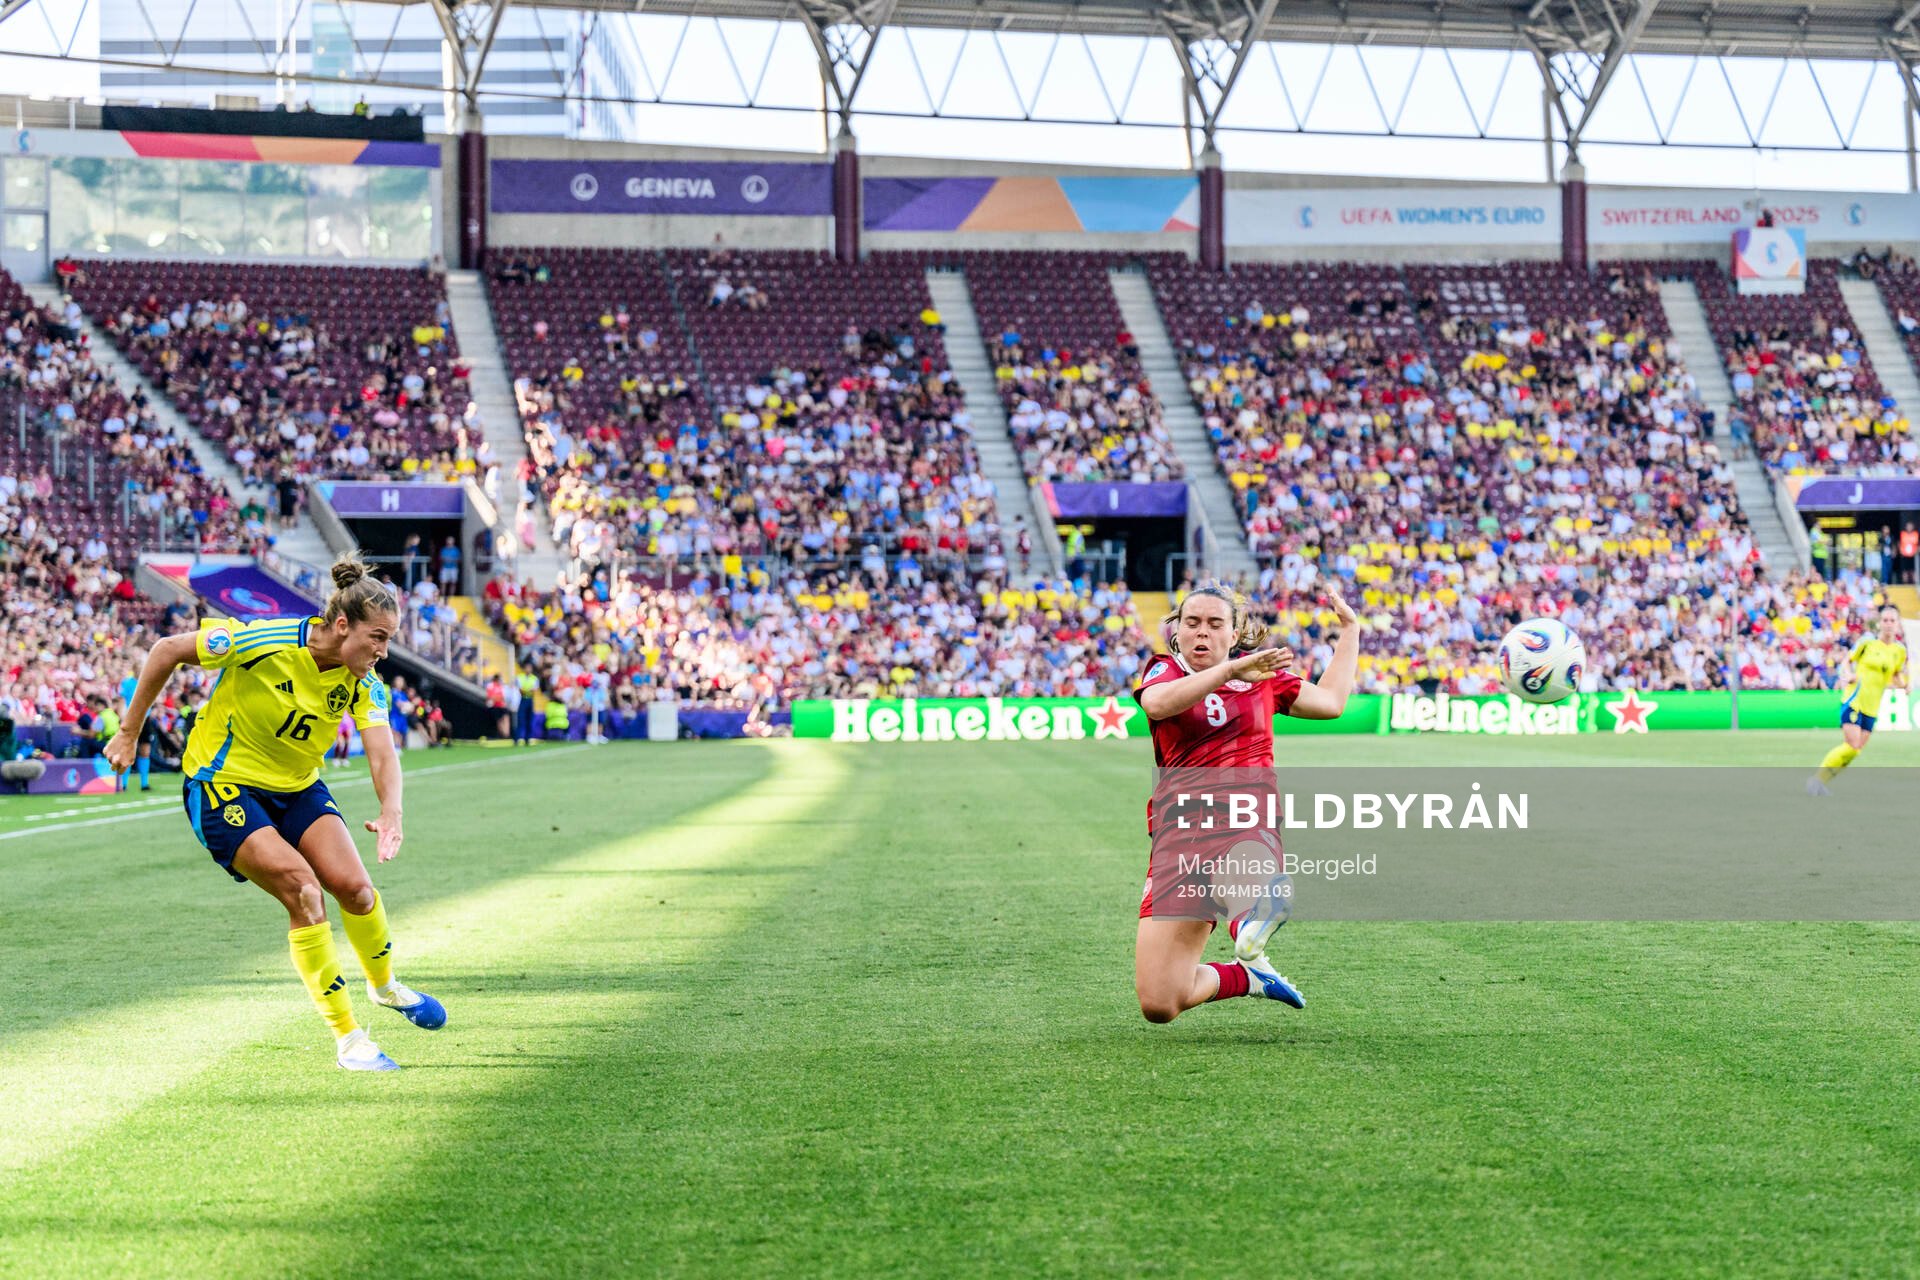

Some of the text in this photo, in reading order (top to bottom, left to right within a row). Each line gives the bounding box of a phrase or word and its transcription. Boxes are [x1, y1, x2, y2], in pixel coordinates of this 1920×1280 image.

[624, 177, 716, 199] GENEVA
[1341, 207, 1545, 225] UEFA WOMEN'S EURO
[1602, 207, 1820, 225] SWITZERLAND 2025
[381, 488, 400, 512] H
[1848, 482, 1863, 505] J
[831, 698, 1086, 742] Heineken
[1204, 693, 1227, 727] 8
[276, 709, 318, 741] 16
[204, 781, 241, 810] 16
